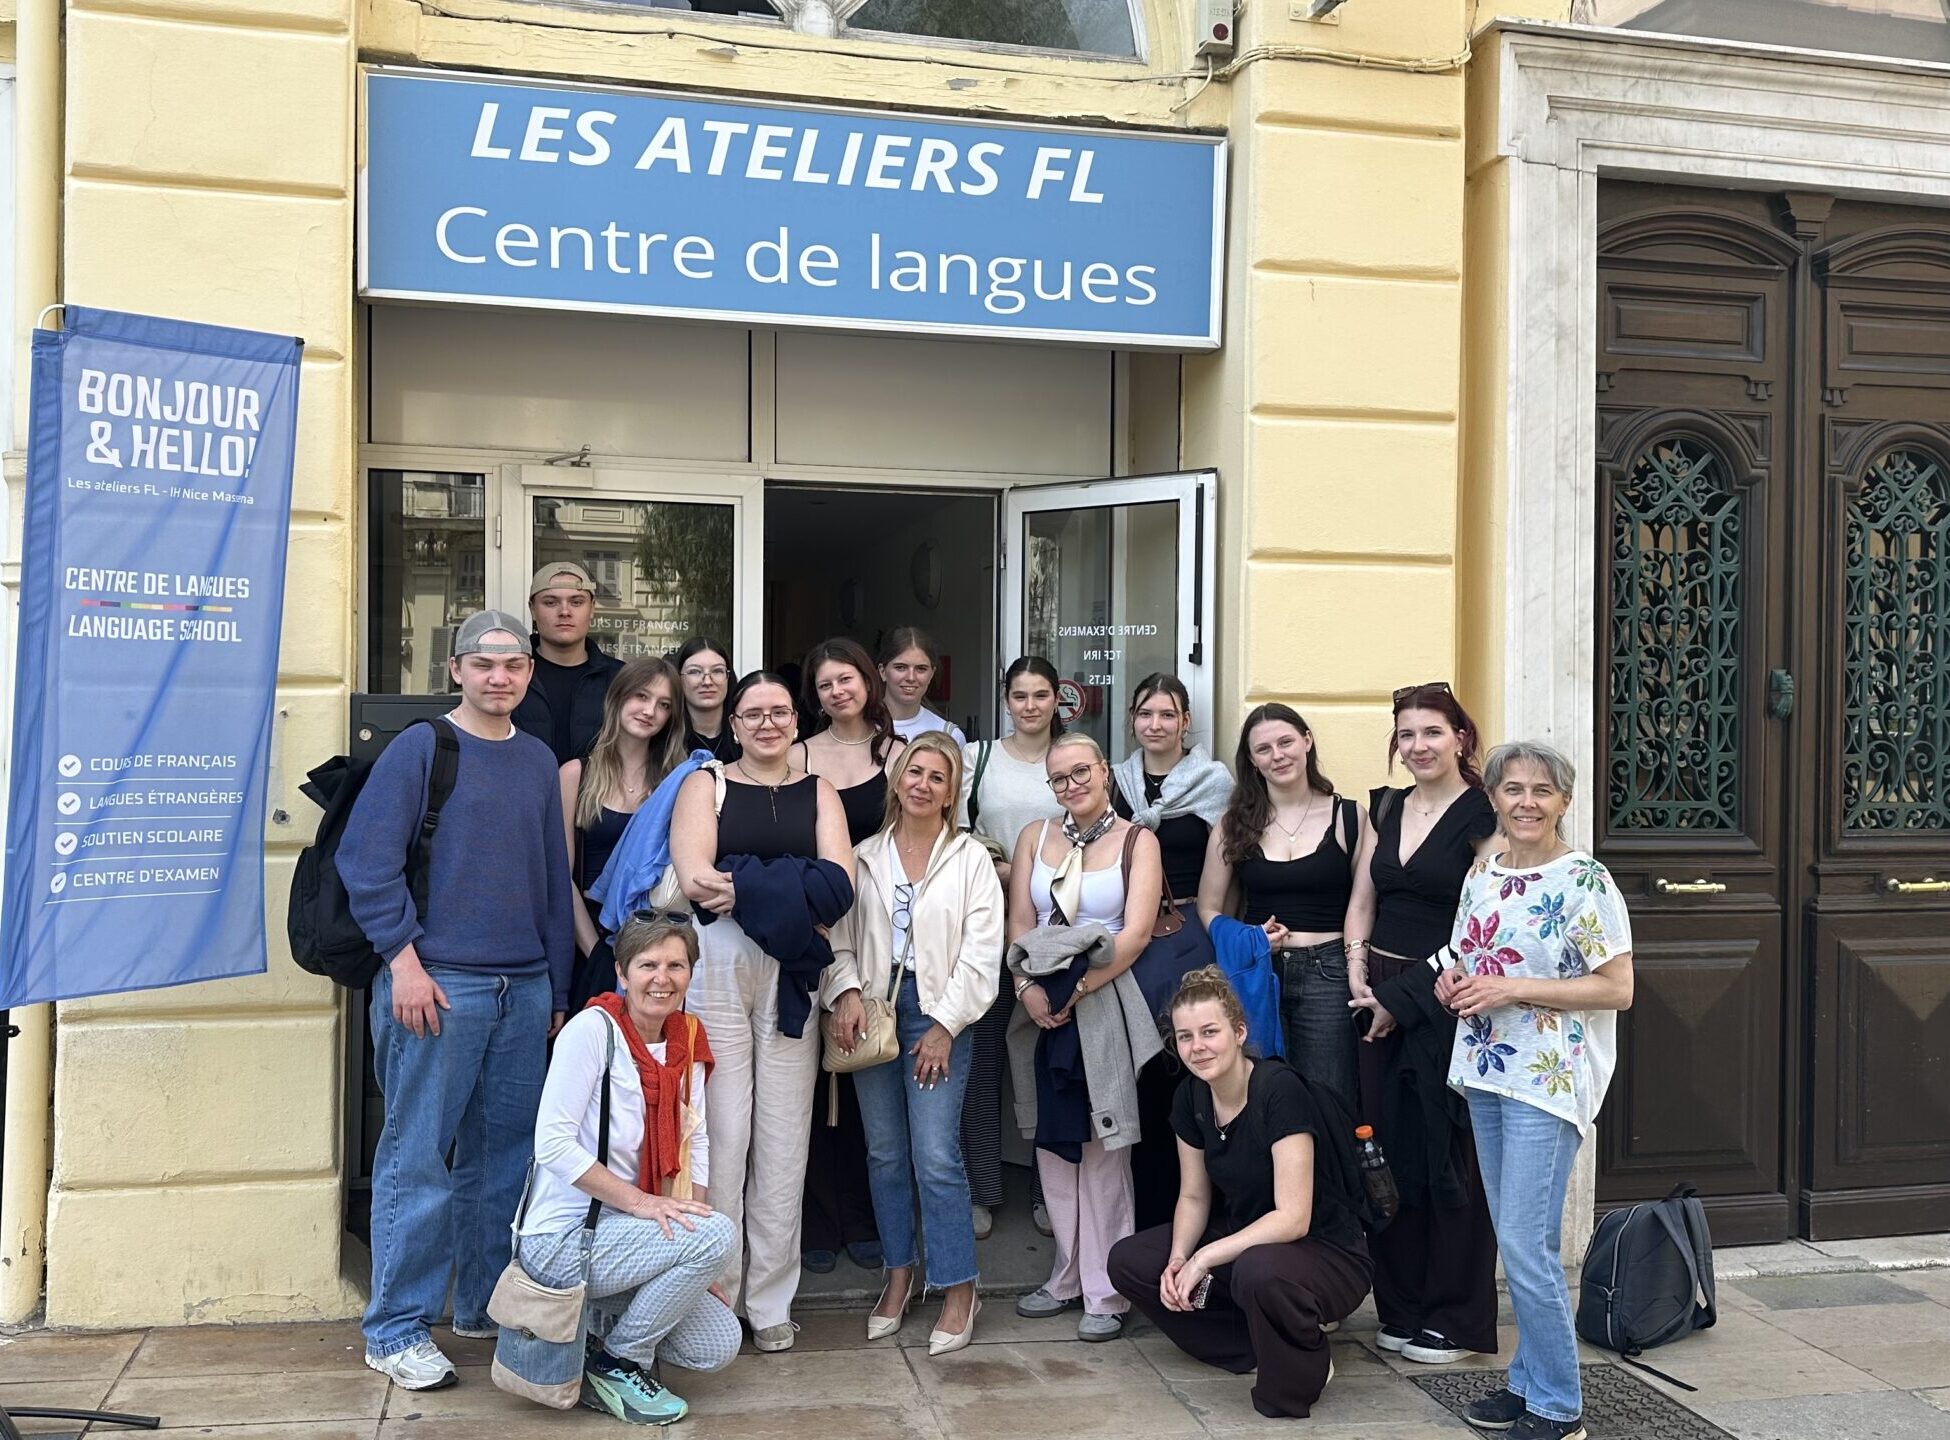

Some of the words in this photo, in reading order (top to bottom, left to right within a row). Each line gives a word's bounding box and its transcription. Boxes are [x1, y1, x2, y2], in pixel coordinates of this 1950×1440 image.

[470, 102, 618, 166] LES
[634, 116, 1005, 196] ATELIERS
[1026, 146, 1104, 204] FL
[435, 206, 716, 279] Centre
[745, 226, 840, 287] de
[870, 232, 1157, 315] langues
[78, 368, 260, 431] BONJOUR
[86, 420, 123, 468] &
[130, 424, 257, 479] HELLO!
[68, 477, 91, 489] Les
[95, 480, 140, 494] ateliers
[144, 484, 160, 496] FL
[170, 487, 181, 498] IH
[182, 488, 209, 501] Nice
[65, 567, 138, 594] CENTRE
[143, 572, 170, 596] DE
[175, 575, 250, 599] LANGUES
[68, 615, 175, 641] LANGUAGE
[179, 619, 242, 643] SCHOOL
[614, 618, 630, 629] DE
[632, 619, 689, 632] FRANÇAIS
[90, 756, 133, 771] COURS
[134, 754, 153, 768] DE
[157, 754, 237, 770] FRANÇAIS
[89, 792, 144, 810] LANGUES
[148, 788, 244, 804] ÉTRANGÈRES
[81, 831, 143, 848] SOUTIEN
[147, 829, 224, 844] SCOLAIRE
[73, 870, 135, 887] CENTRE
[139, 867, 219, 883] D'EXAMEN
